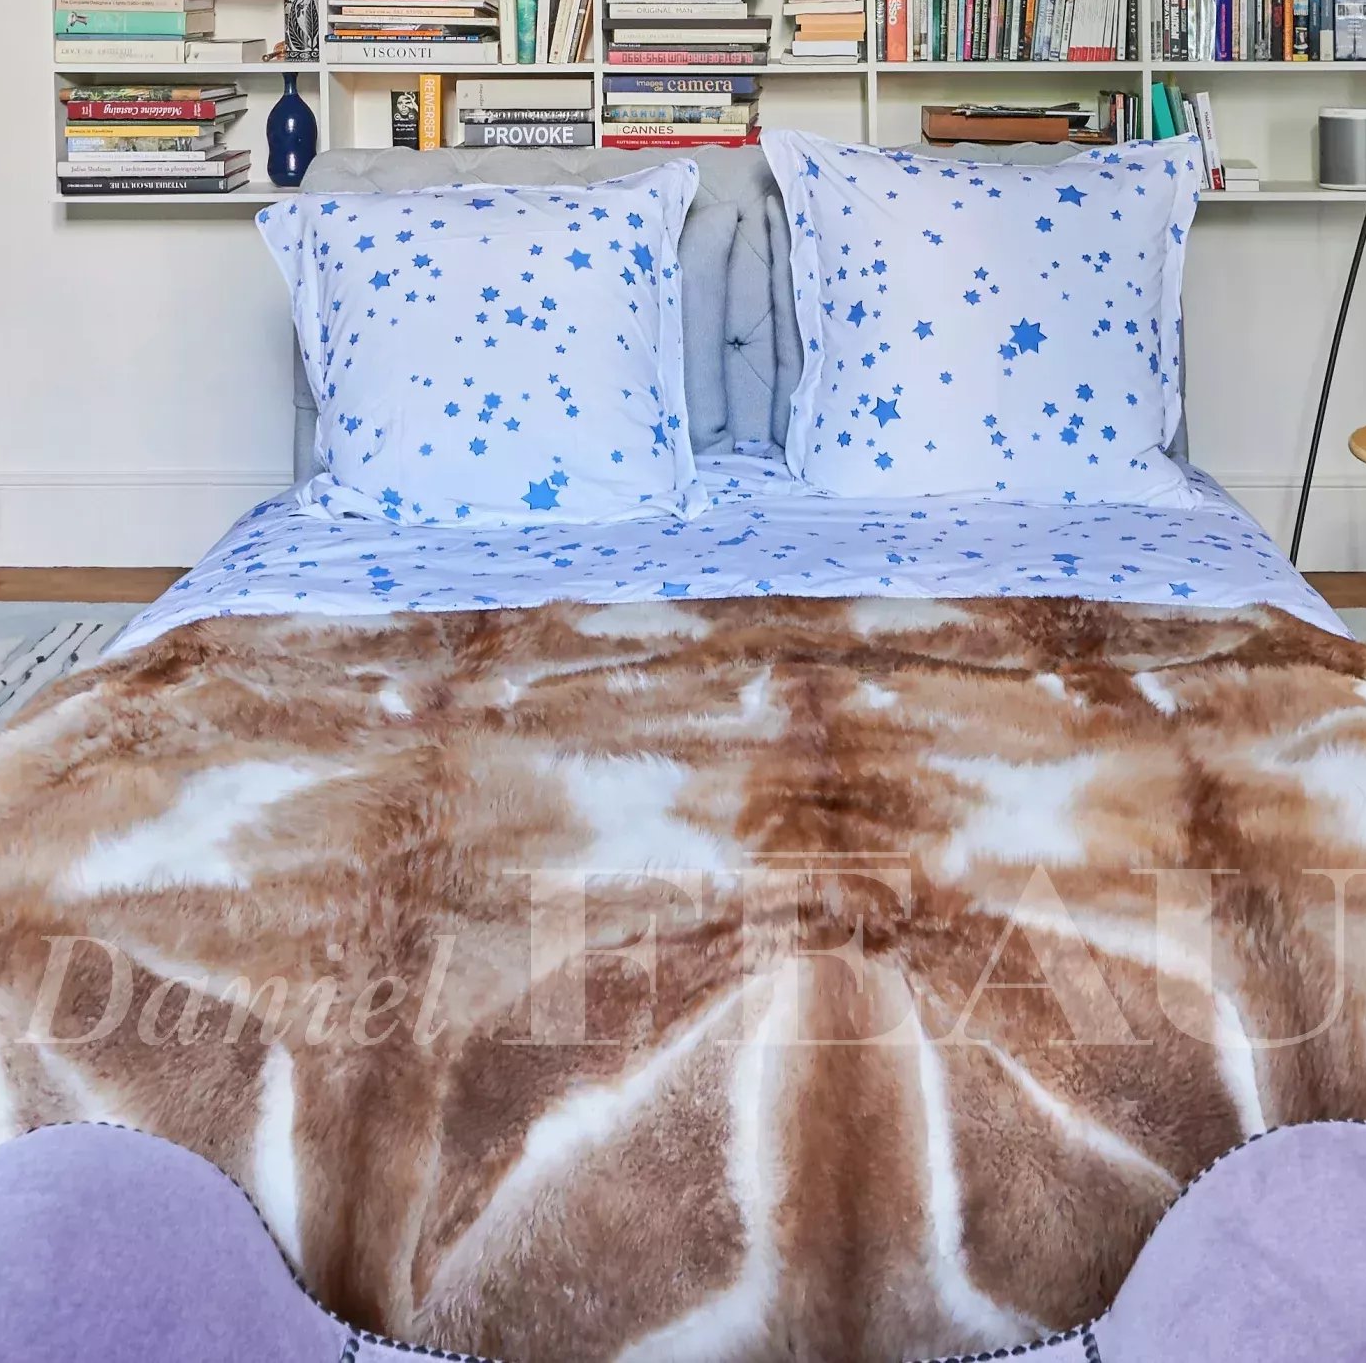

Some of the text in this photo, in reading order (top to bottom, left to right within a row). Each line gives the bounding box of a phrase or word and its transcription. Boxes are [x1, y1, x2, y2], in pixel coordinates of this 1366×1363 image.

[635, 5, 693, 14] ORIGINAL MAN
[888, 0, 897, 26] OSS
[1170, 6, 1180, 40] APOCALYPSE
[362, 47, 431, 59] VISCONTI
[621, 53, 667, 63] 1945-1990
[666, 79, 733, 92] camera
[104, 104, 183, 116] Madeleine Castaing
[424, 78, 435, 139] RENVERSER
[610, 109, 666, 118] MAGNUM
[483, 126, 573, 144] PROVOKE
[621, 126, 673, 134] CANNES
